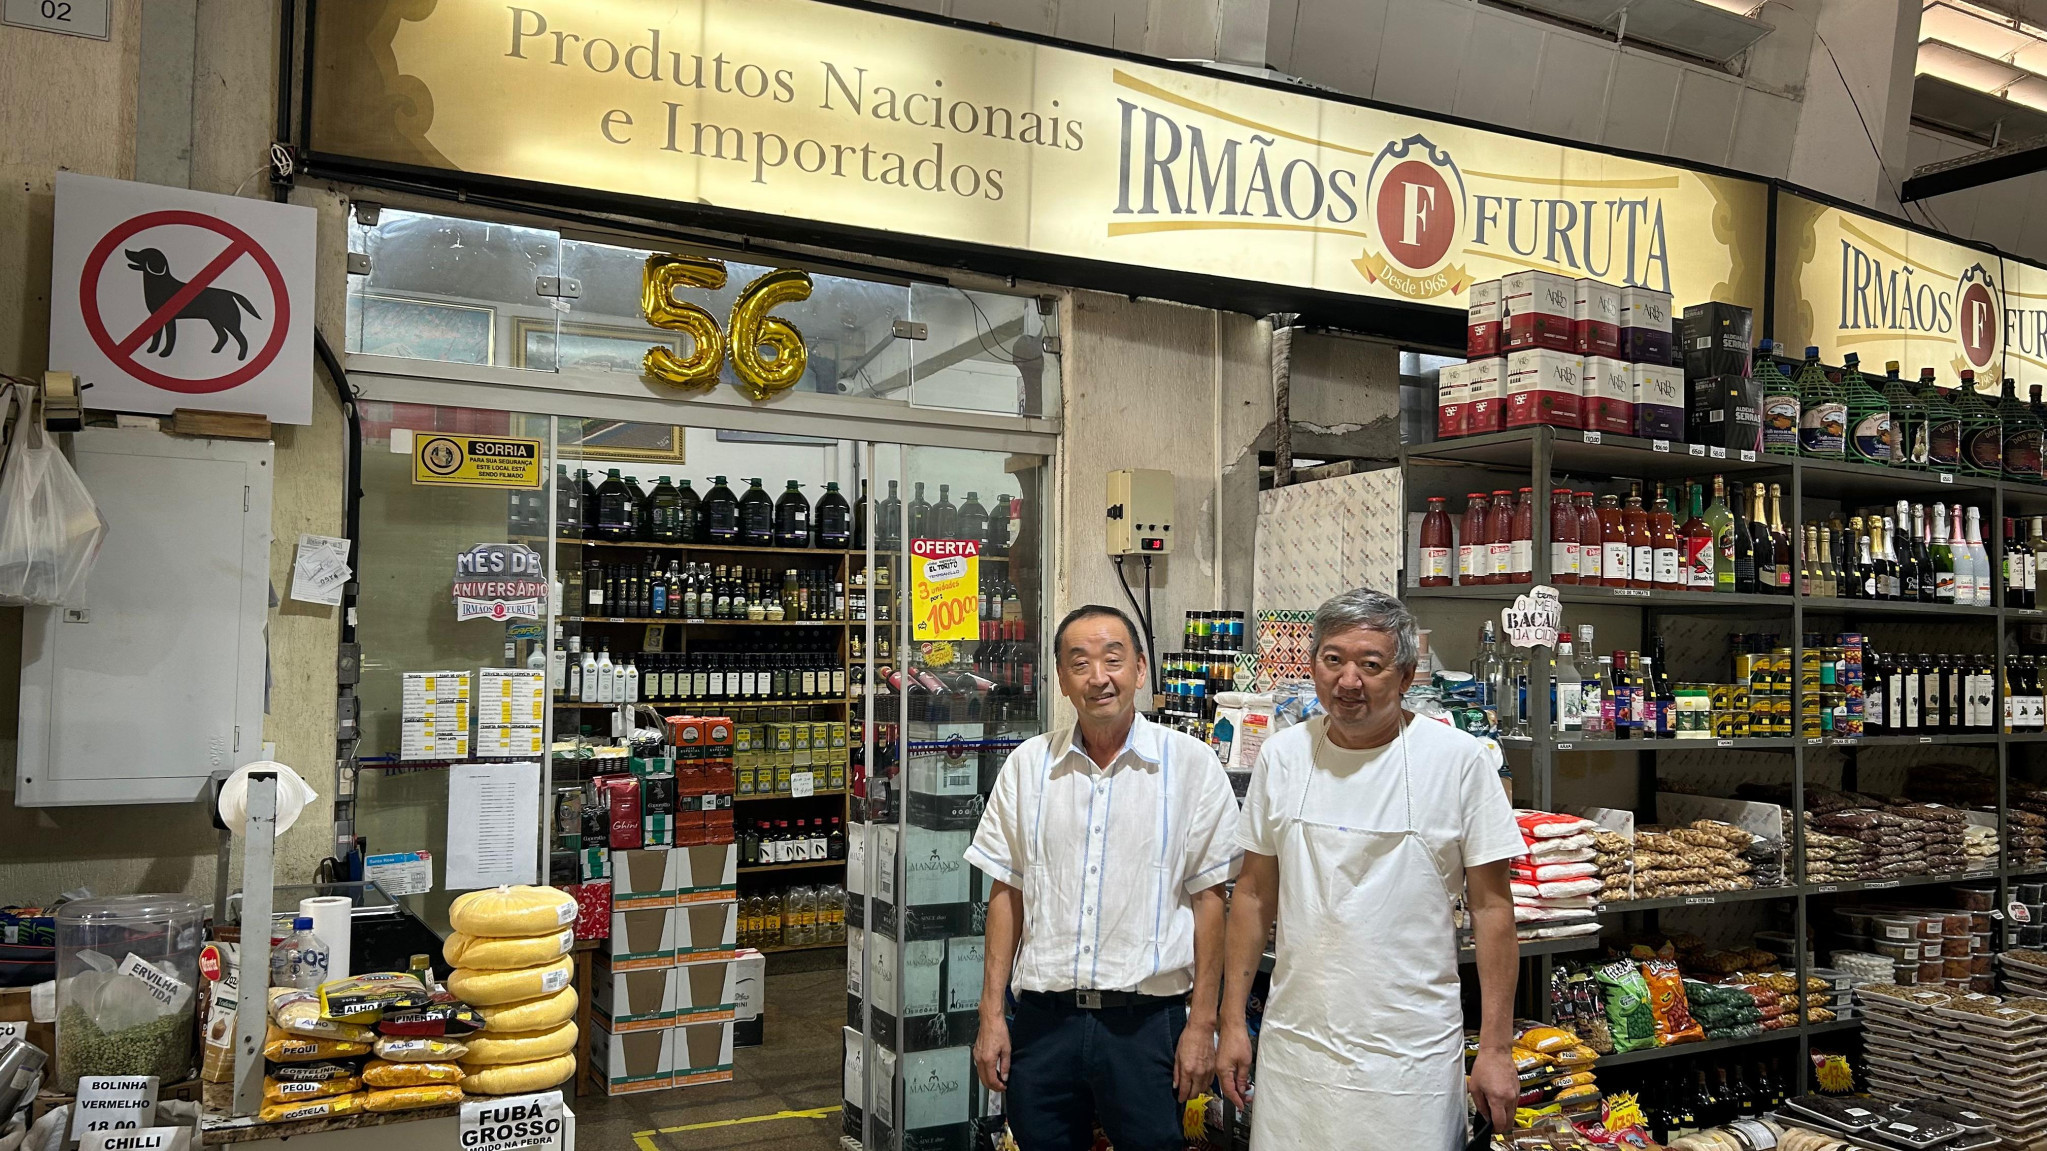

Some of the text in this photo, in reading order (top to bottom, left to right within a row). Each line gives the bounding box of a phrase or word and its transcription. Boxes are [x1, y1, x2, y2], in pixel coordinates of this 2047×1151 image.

[41, 0, 72, 21] 02
[505, 7, 1084, 151] Produtos Nacionais
[601, 101, 1004, 200] e Importados
[1113, 98, 1672, 298] IRMÃOS F FURUTA
[1380, 265, 1447, 296] Desde 1968
[1838, 239, 1952, 333] IRMÃOS
[1971, 300, 1987, 349] F
[475, 443, 527, 456] SORRIA
[498, 458, 533, 466] SEGURANÇA
[914, 541, 976, 554] OFERTA
[458, 549, 540, 573] MÊS DE
[452, 580, 548, 597] ANIVERSÁRIO
[918, 580, 960, 600] 3 unidades
[507, 604, 536, 614] FURUTA
[131, 963, 178, 995] ERVILHA
[346, 1003, 375, 1014] ALHO
[302, 1019, 329, 1028] ALHO
[396, 1014, 440, 1023] PIMENTA
[283, 1044, 316, 1054] PEQUI
[389, 1042, 414, 1050] ALHO
[92, 1081, 147, 1090] BOLINHA
[82, 1100, 150, 1109] VERMELHO
[285, 1106, 326, 1119] COSTELA
[479, 1099, 543, 1126] FUBÁ
[462, 1118, 560, 1147] GROSSO
[104, 1136, 161, 1150] CHILLI
[504, 1141, 518, 1149] NA
[520, 1136, 553, 1146] PEDRA
